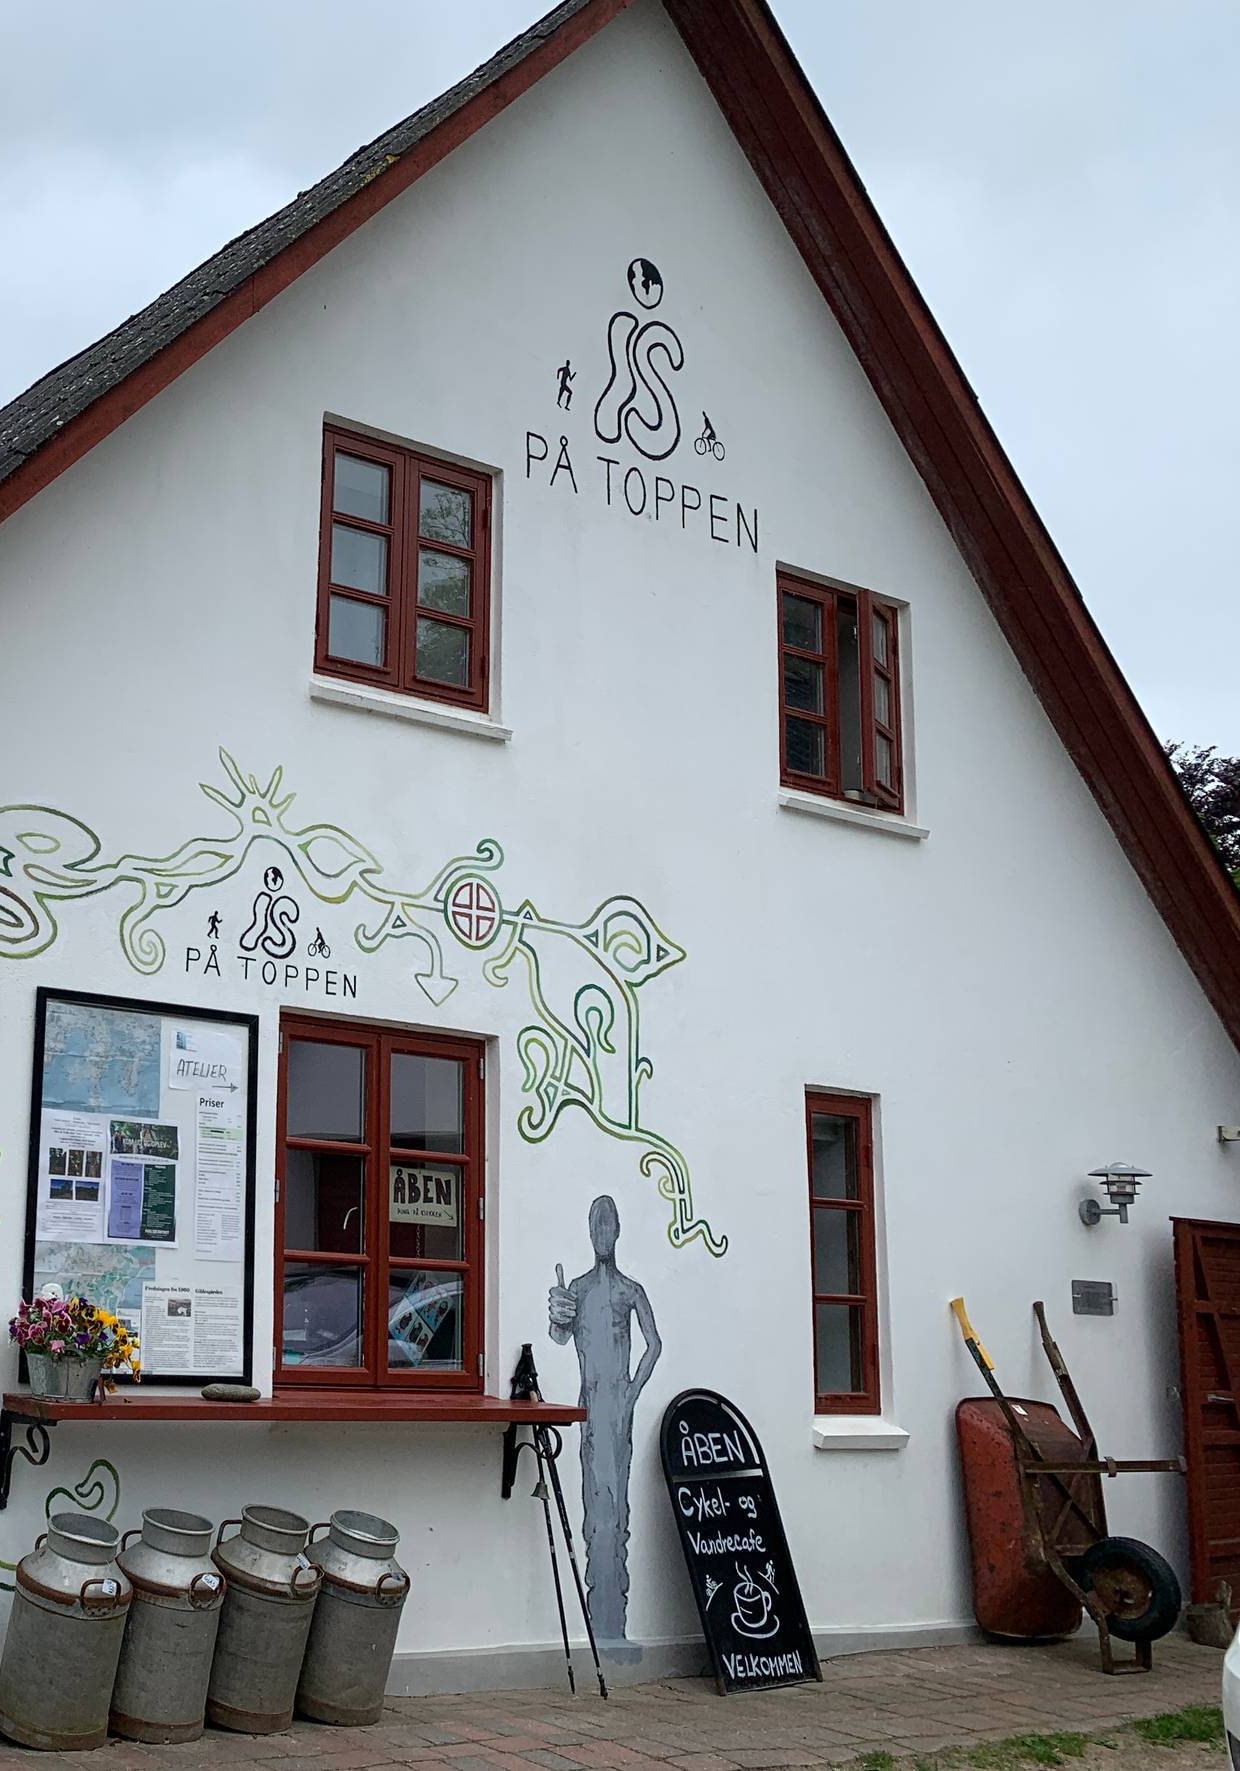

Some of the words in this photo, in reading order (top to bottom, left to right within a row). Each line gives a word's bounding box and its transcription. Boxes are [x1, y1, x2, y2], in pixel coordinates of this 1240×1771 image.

[526, 431, 578, 494] PÅ
[596, 456, 758, 554] TOPPEN
[185, 944, 221, 977] PÅ
[237, 955, 357, 999] TOPPEN
[176, 1058, 228, 1082] ATELIER
[199, 1097, 225, 1109] Priser
[393, 1168, 452, 1206] ÅBEN
[678, 1420, 745, 1467] ÅBEN
[677, 1486, 731, 1523] Cykel-
[738, 1494, 758, 1519] og
[686, 1528, 767, 1556] Vandrecafe
[721, 1648, 804, 1681] VELKOMMEN
